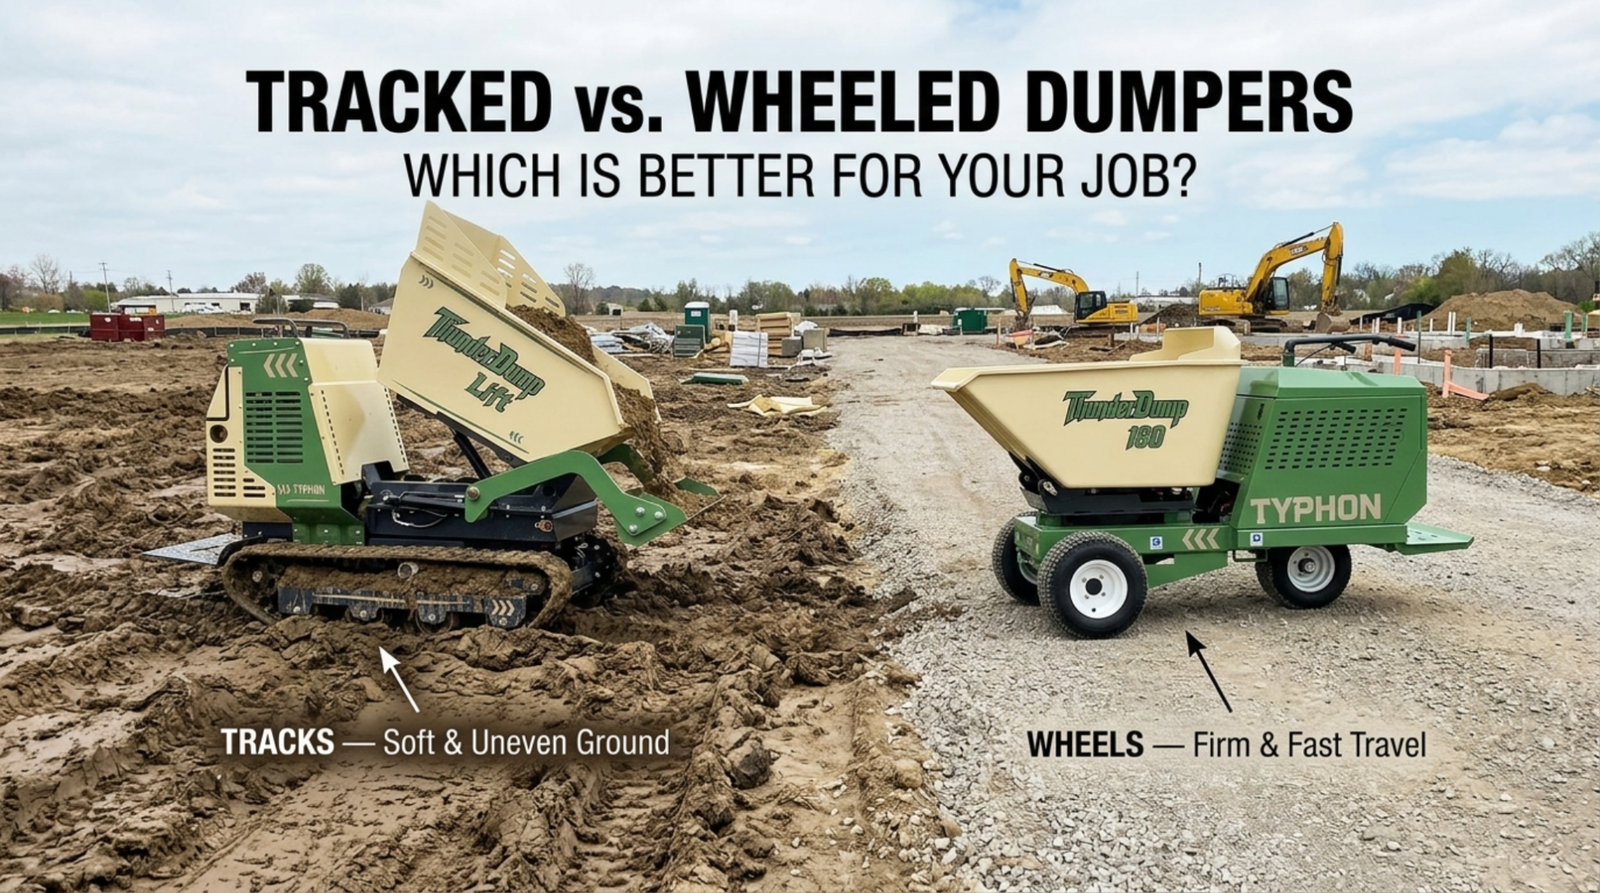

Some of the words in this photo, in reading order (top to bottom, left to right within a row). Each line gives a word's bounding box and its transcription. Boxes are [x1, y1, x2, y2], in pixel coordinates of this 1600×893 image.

[423, 306, 546, 400] ThunderDump
[1062, 390, 1189, 428] ThunderDump
[1125, 424, 1167, 450] 180
[1250, 493, 1381, 524] TYPHON
